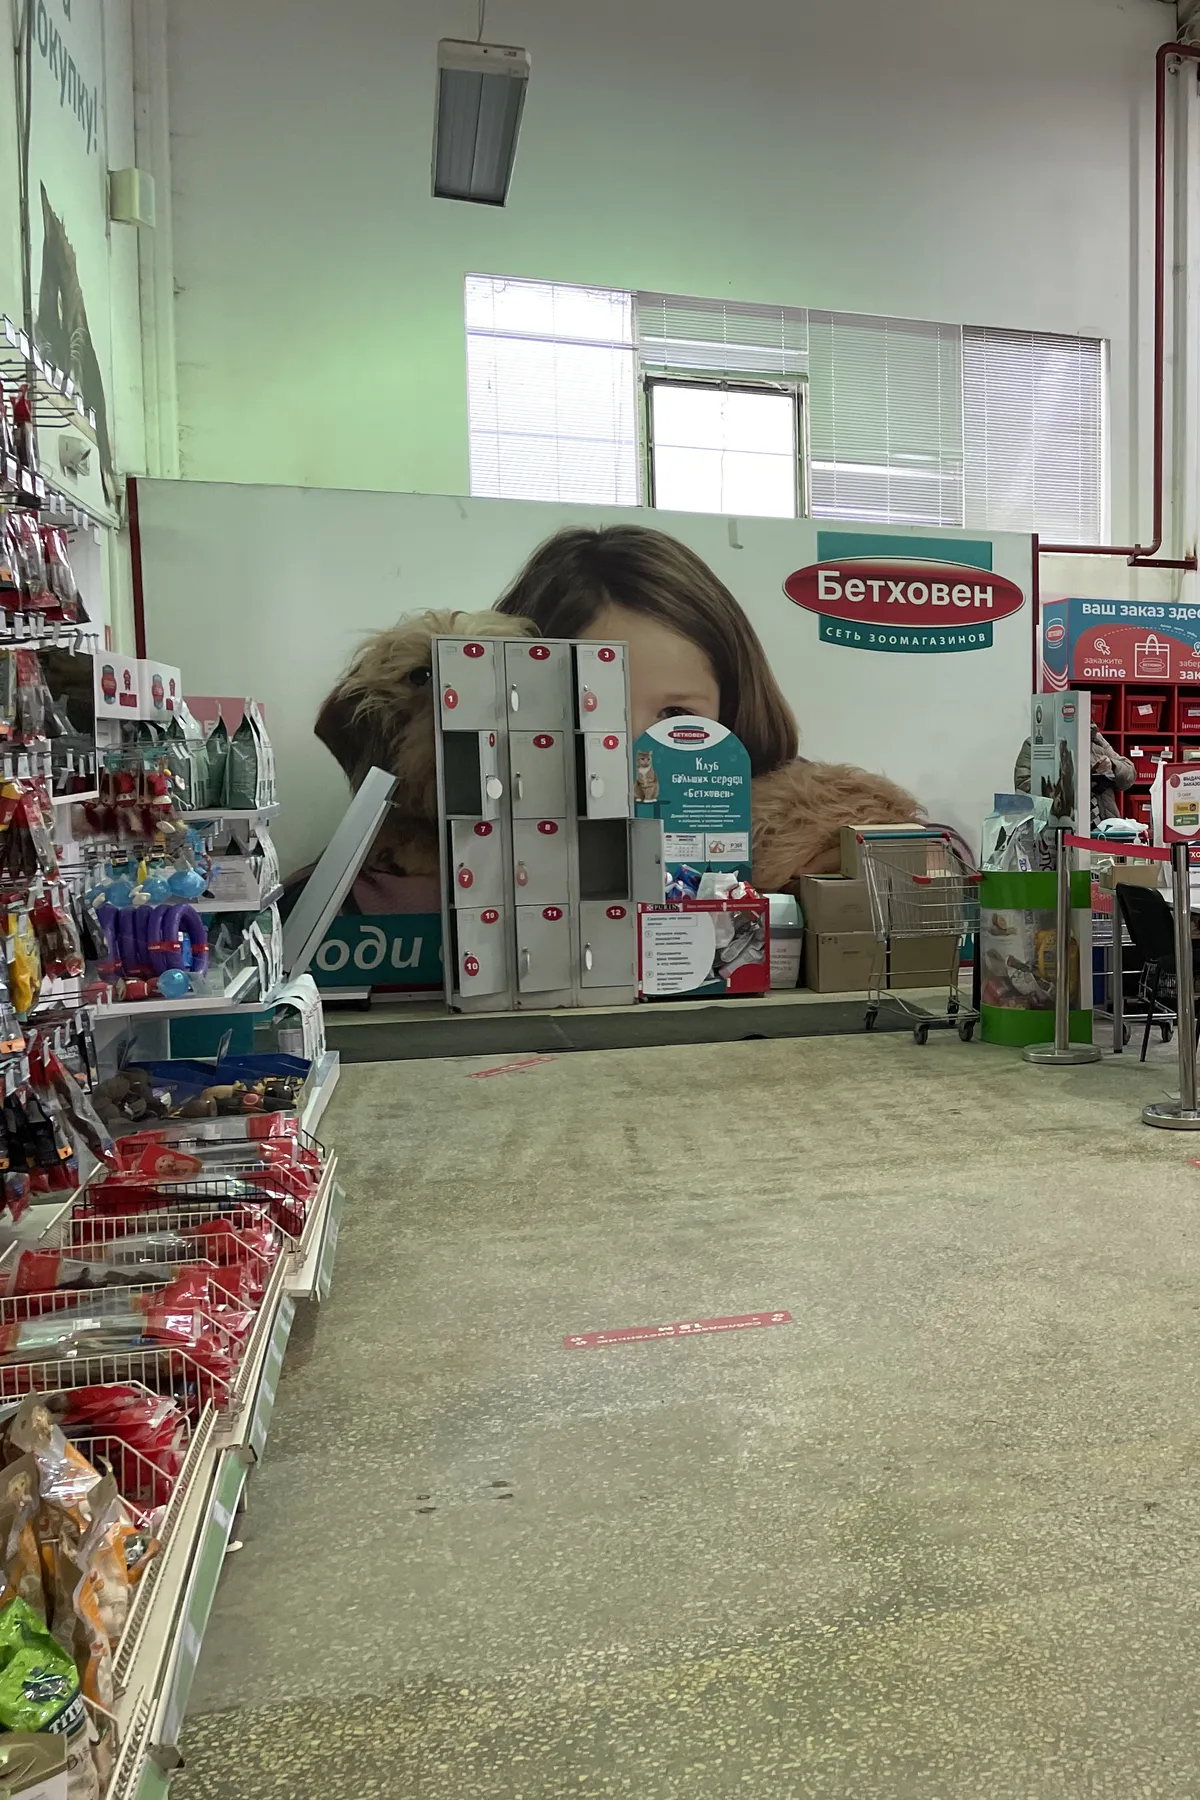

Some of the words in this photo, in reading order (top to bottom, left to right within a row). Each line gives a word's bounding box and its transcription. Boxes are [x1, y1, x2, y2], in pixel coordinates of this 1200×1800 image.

[33, 0, 98, 155] окупку!
[817, 569, 994, 608] Бетховен
[1082, 603, 1117, 616] ваш
[1120, 605, 1165, 618] заказ
[825, 626, 861, 641] СЕТЬ
[869, 633, 986, 646] ЗООМАГАЗИНОВ
[1083, 657, 1124, 665] закажите
[1083, 665, 1127, 678] online
[695, 757, 719, 773] Клуб
[711, 774, 743, 787] сердец
[316, 925, 423, 972] оди
